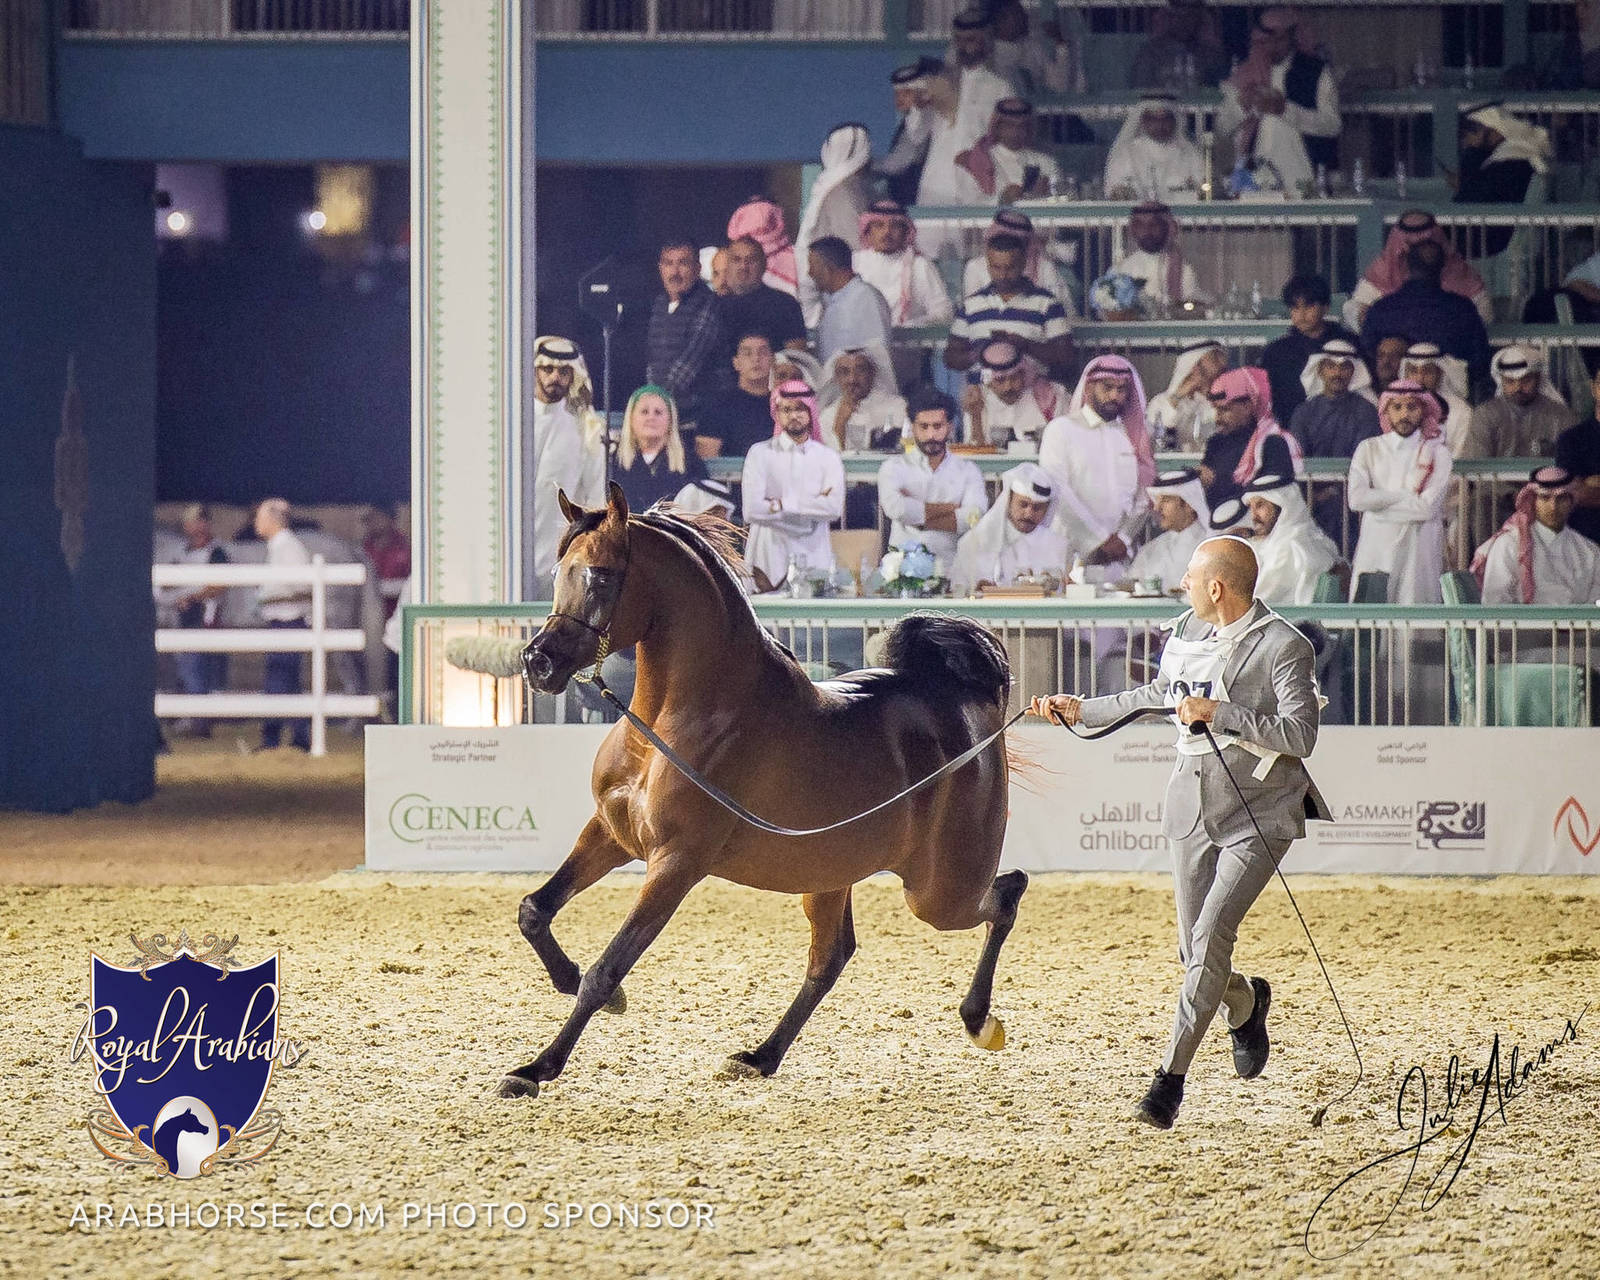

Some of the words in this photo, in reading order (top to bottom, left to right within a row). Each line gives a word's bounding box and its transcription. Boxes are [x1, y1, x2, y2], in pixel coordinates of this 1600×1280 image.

[432, 753, 466, 763] Strategic
[468, 753, 496, 762] Partner
[1395, 754, 1427, 764] Sponsor
[402, 805, 539, 831] CENECA
[1343, 804, 1412, 819] ASMAKH
[1080, 830, 1168, 850] ahliban
